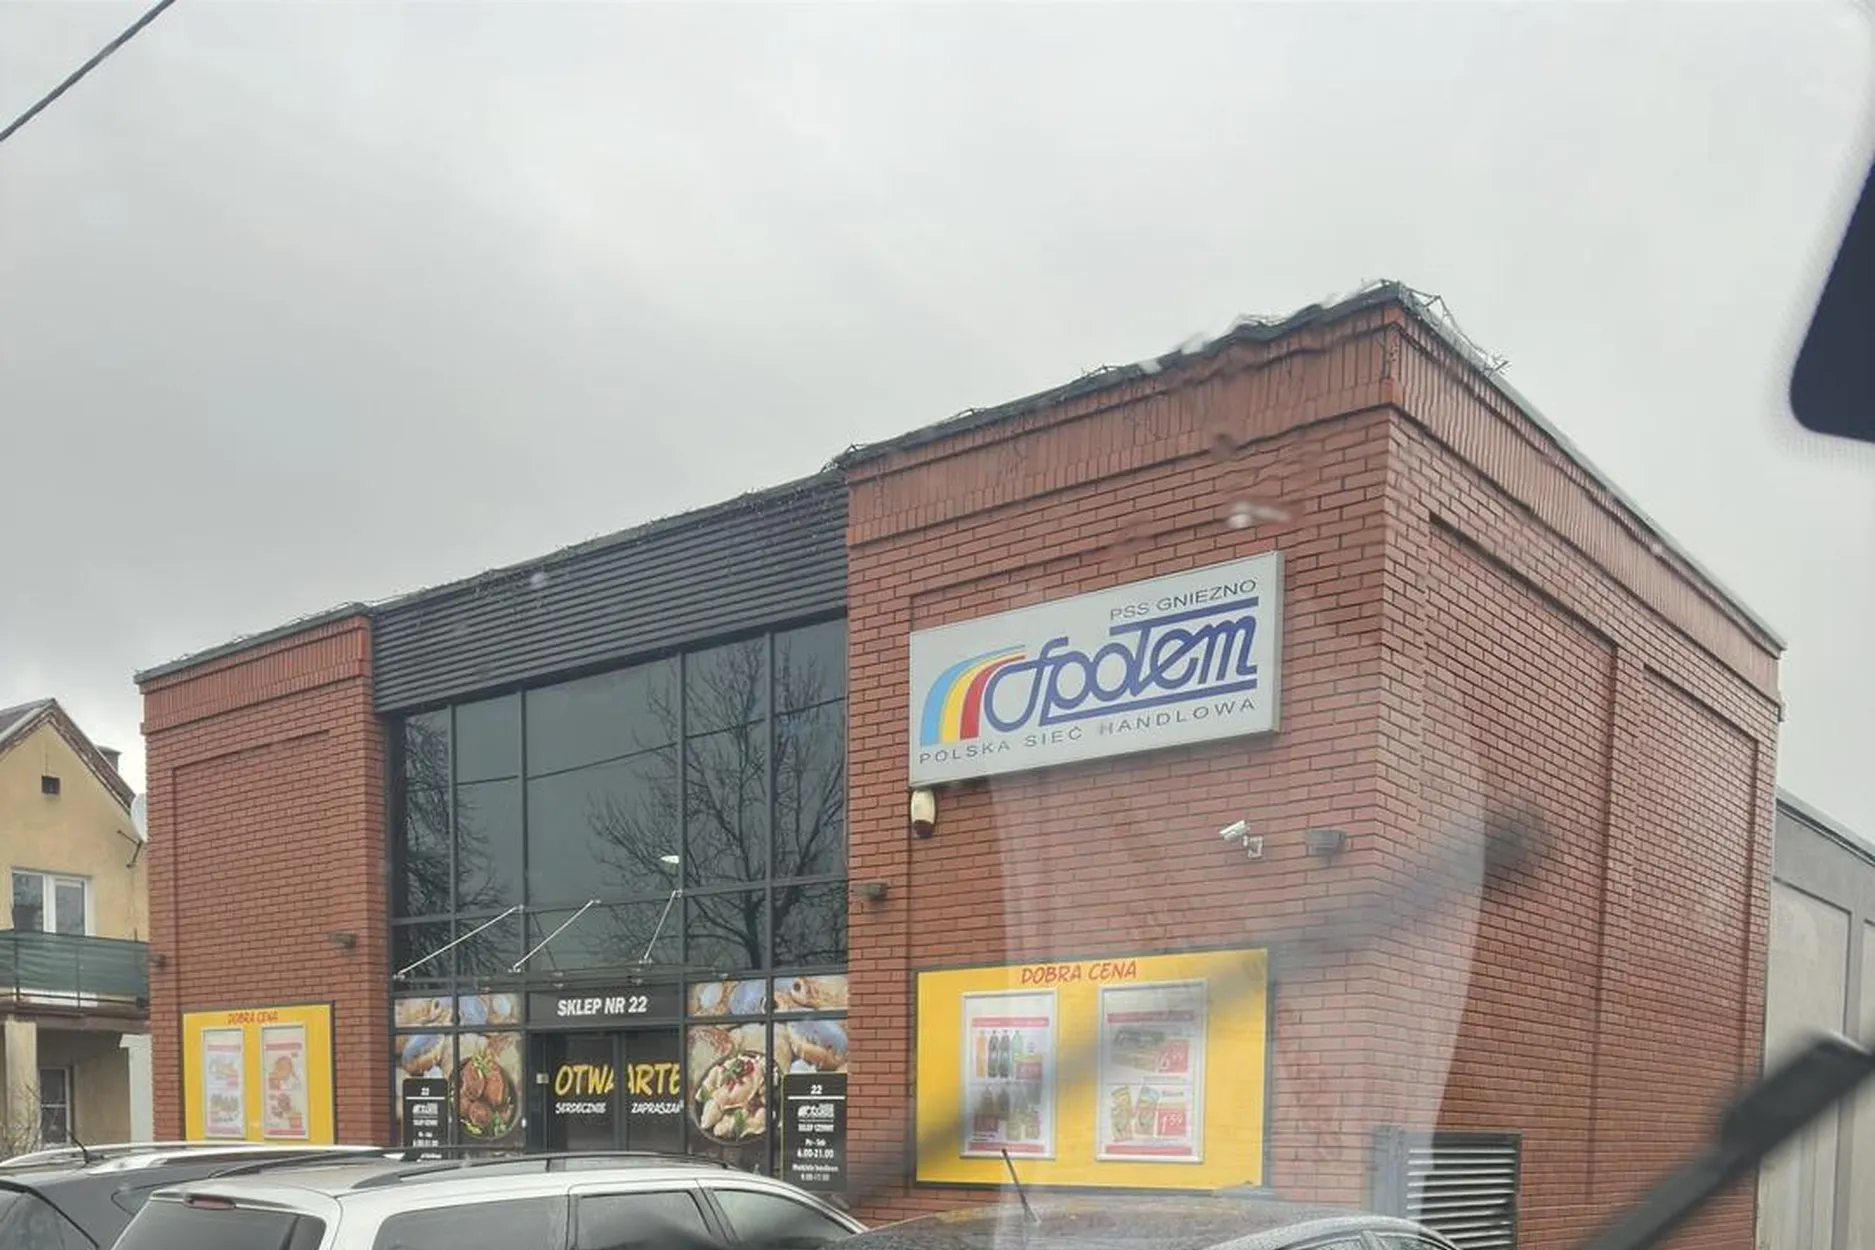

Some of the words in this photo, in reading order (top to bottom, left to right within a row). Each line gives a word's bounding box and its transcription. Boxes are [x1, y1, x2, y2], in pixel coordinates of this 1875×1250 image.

[1110, 602, 1150, 621] PSS
[1156, 579, 1256, 611] GNIEZNO
[919, 739, 1010, 764] POLSKA
[1099, 698, 1256, 736] HANDLOWA
[1021, 964, 1081, 984] DOBRA
[1088, 960, 1137, 981] CENA
[557, 998, 602, 1016] SKLEP
[604, 996, 626, 1014] NR
[628, 995, 648, 1013] 22
[810, 1084, 823, 1095] 22
